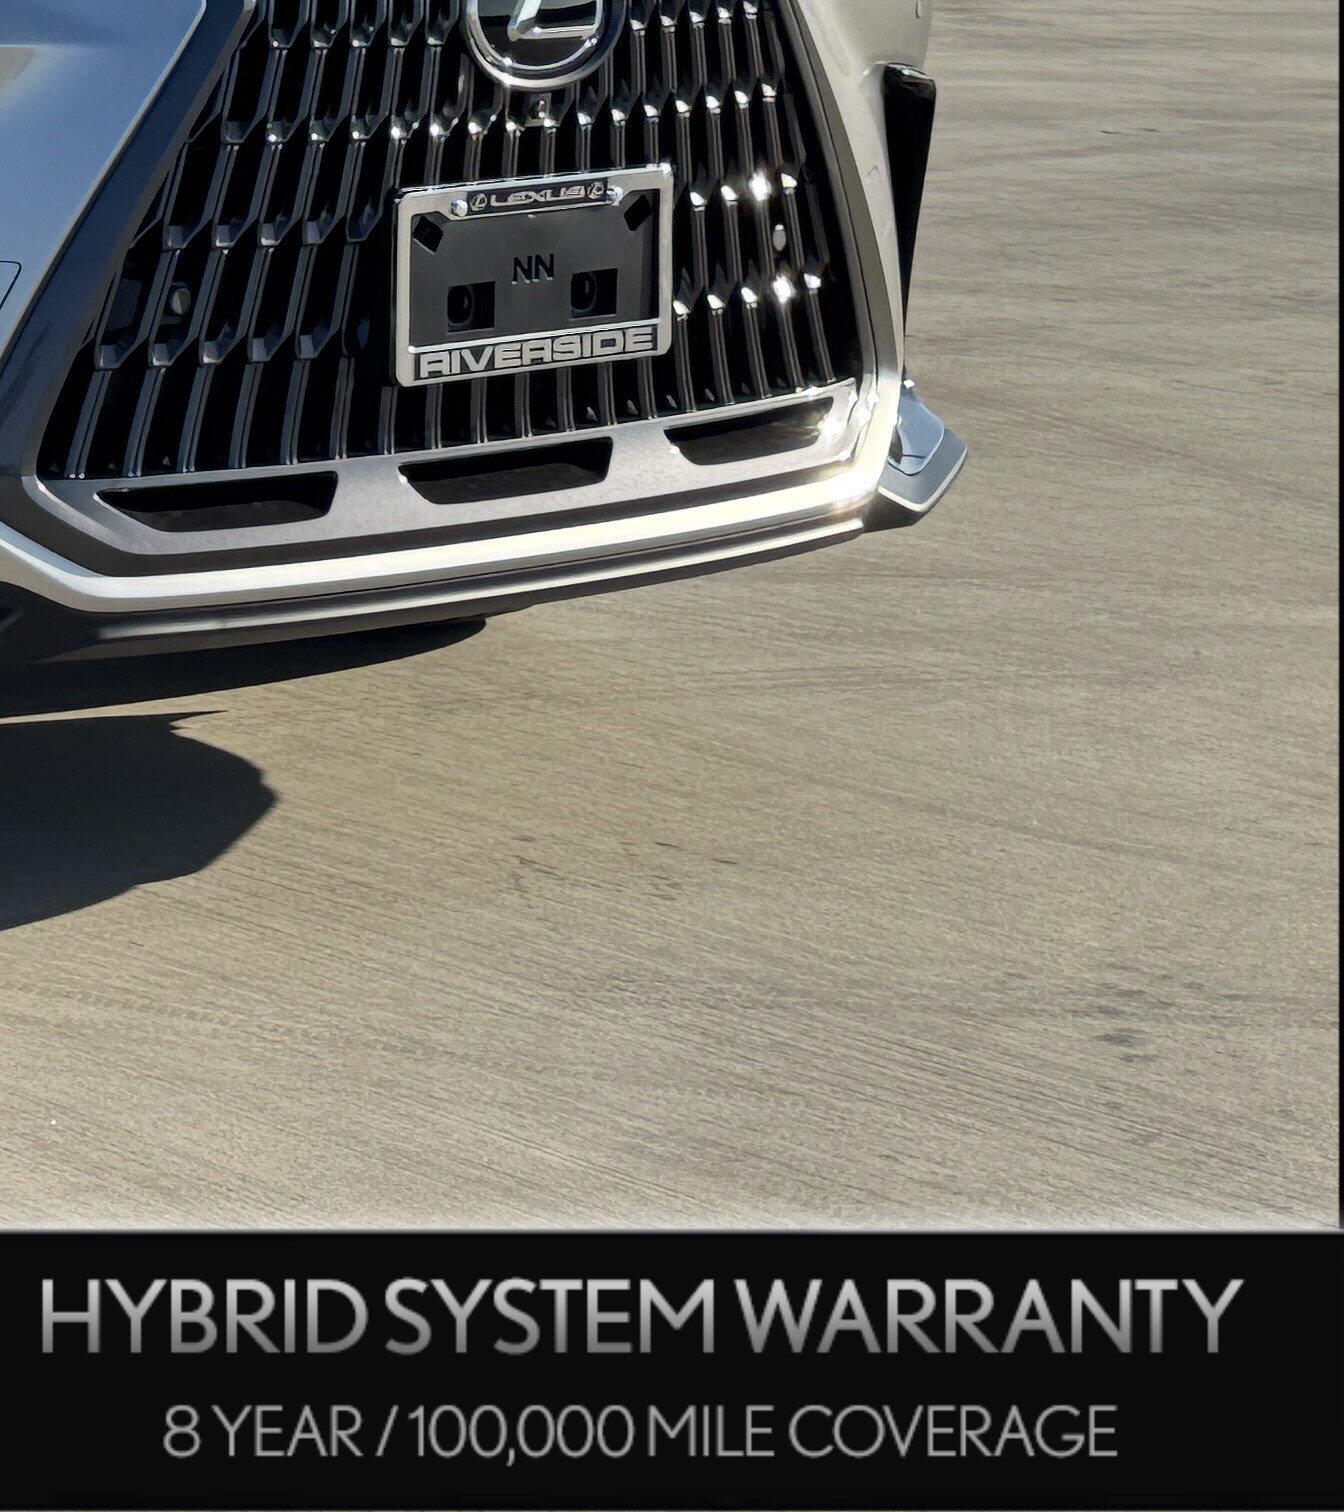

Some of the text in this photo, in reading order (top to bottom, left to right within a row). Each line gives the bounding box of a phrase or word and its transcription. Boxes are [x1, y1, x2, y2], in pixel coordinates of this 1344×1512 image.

[489, 185, 585, 207] LEXUS
[512, 253, 555, 285] NN
[419, 326, 654, 379] RIVERSIDE
